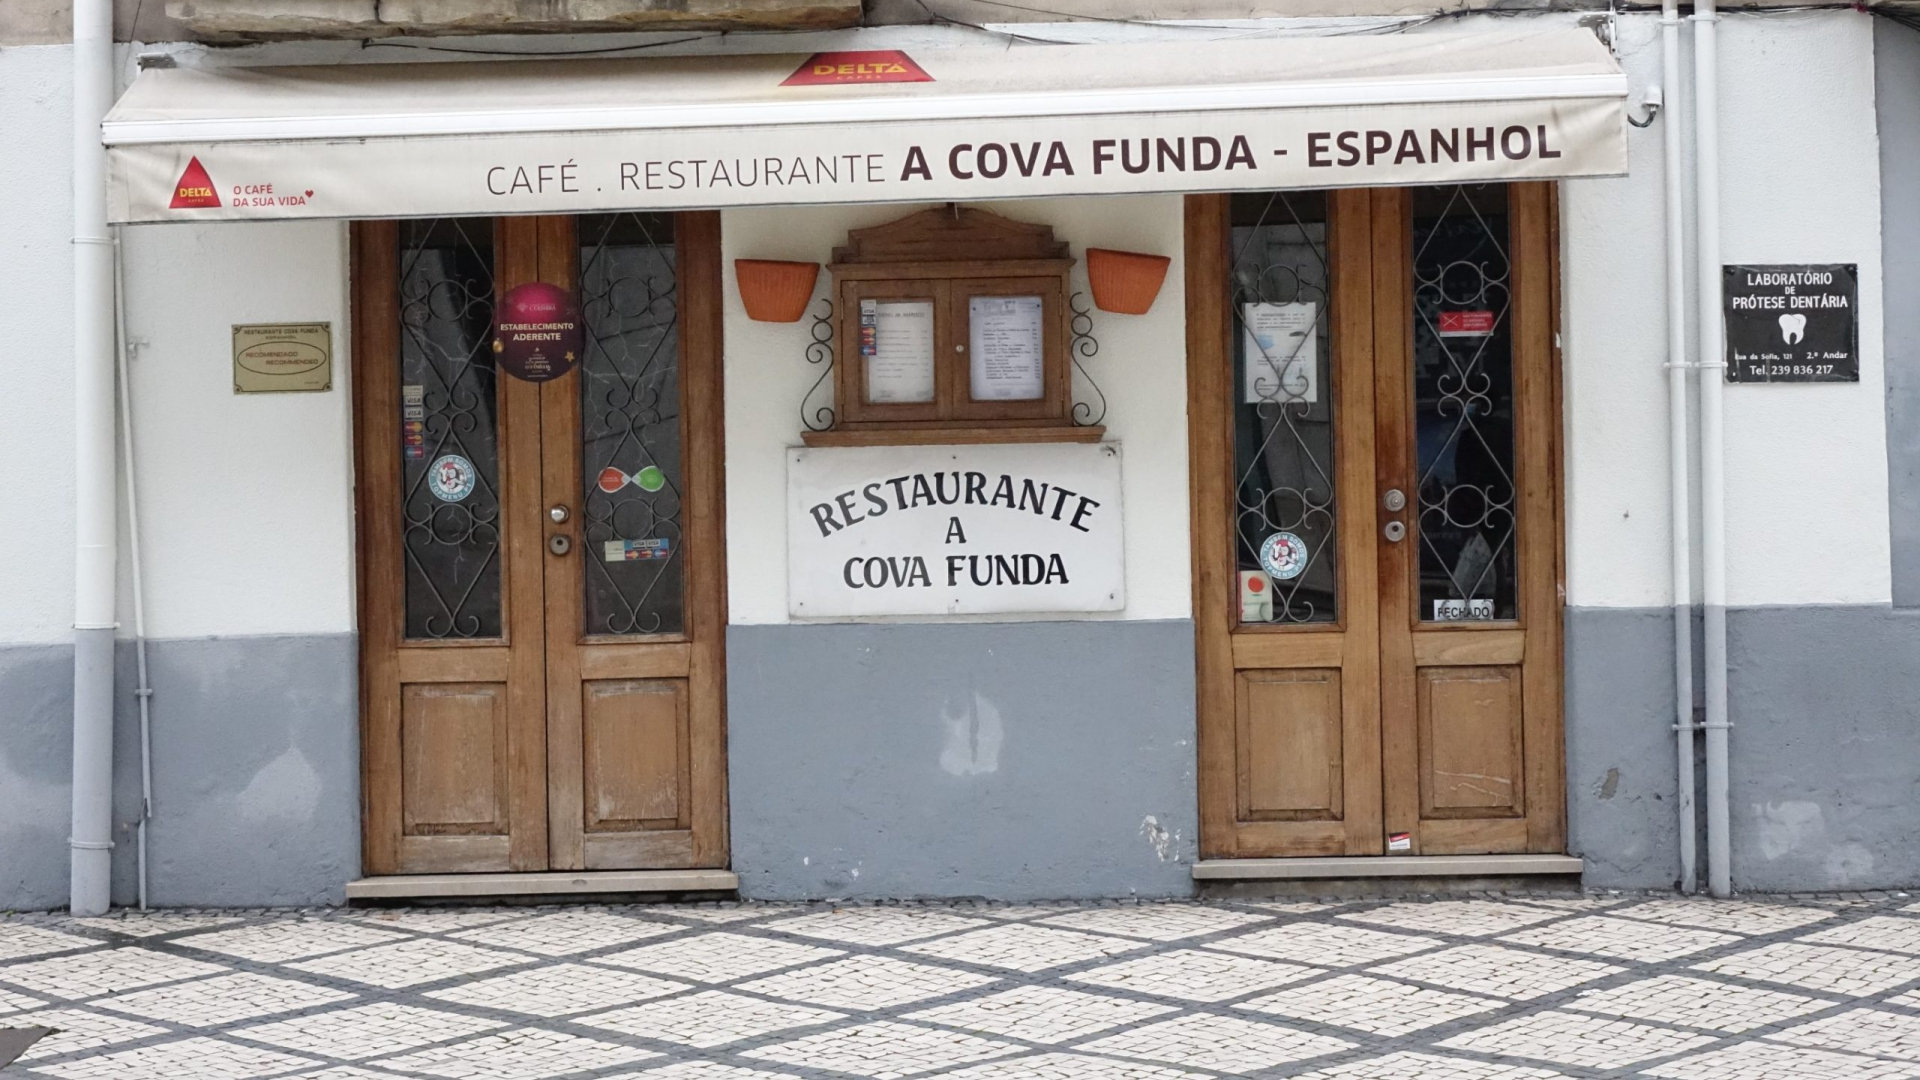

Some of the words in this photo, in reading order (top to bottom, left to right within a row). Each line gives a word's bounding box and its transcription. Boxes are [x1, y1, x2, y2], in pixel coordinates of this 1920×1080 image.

[813, 63, 907, 75] DELTA
[487, 159, 580, 196] CAFÉ
[620, 153, 886, 191] RESTAURANTE
[900, 145, 933, 181] A
[948, 140, 1075, 180] COVA
[1092, 134, 1258, 176] FUNDA
[1307, 124, 1562, 168] ESPANHOL
[179, 187, 213, 198] DELTA
[233, 185, 242, 195] O
[245, 183, 274, 195] CAFÉ
[233, 197, 249, 208] DA
[252, 196, 275, 207] SUA
[278, 196, 306, 206] VIDA
[1747, 271, 1833, 286] LABORATÓRIO
[1784, 286, 1796, 295] DE
[1732, 294, 1786, 309] PRÓTESE
[1790, 293, 1848, 308] DENTÁRIA
[500, 322, 574, 331] ESTABELECIMENTO
[513, 332, 562, 341] ADERENTE
[1761, 353, 1780, 361] Sofia,
[1823, 350, 1848, 359] Andar
[1749, 364, 1768, 375] Tel.
[1771, 365, 1791, 375] 239
[1793, 365, 1813, 375] 836
[1816, 364, 1834, 374] 217
[809, 471, 1101, 538] RESTAURANTE
[945, 516, 967, 544] A
[843, 555, 932, 588] COVA
[946, 553, 1070, 587] FUNDA
[1437, 606, 1490, 618] FECHADO
